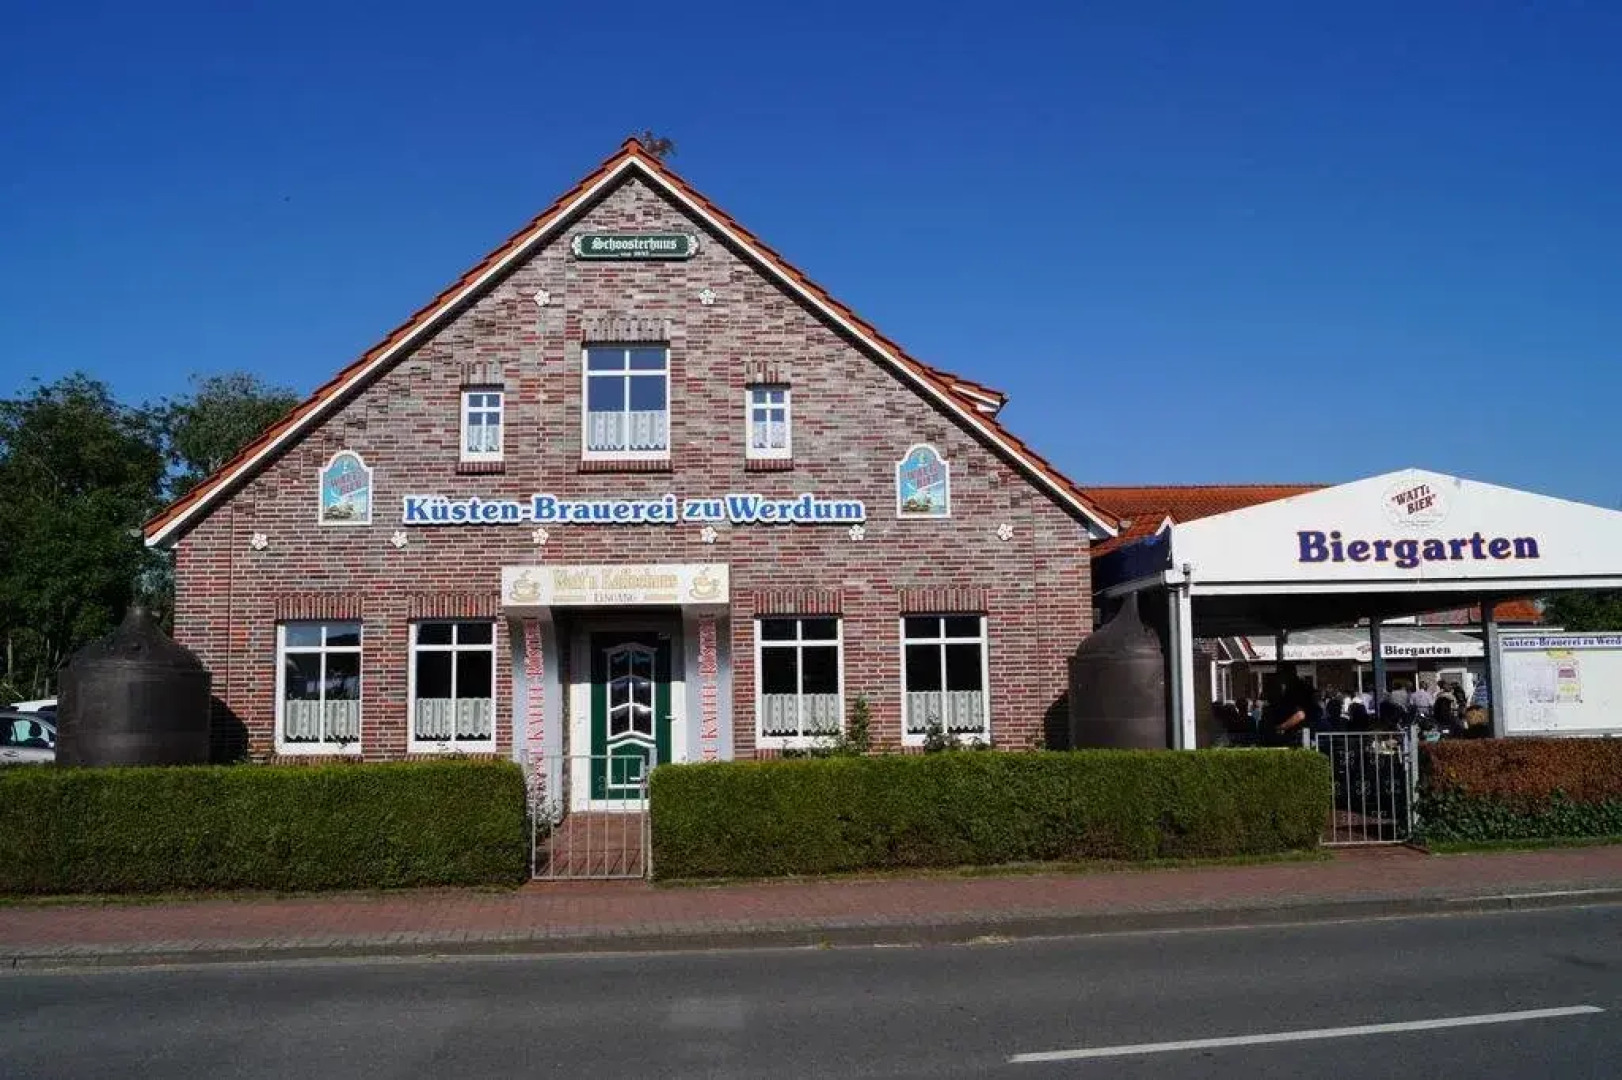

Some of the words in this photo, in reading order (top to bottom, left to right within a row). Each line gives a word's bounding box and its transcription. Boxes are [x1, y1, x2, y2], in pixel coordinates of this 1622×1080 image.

[405, 494, 675, 521] Küsten-Brauerei
[685, 501, 722, 518] zu
[727, 495, 863, 519] Werdum
[1296, 530, 1541, 569] Biergarten
[1384, 644, 1451, 656] Biergarten
